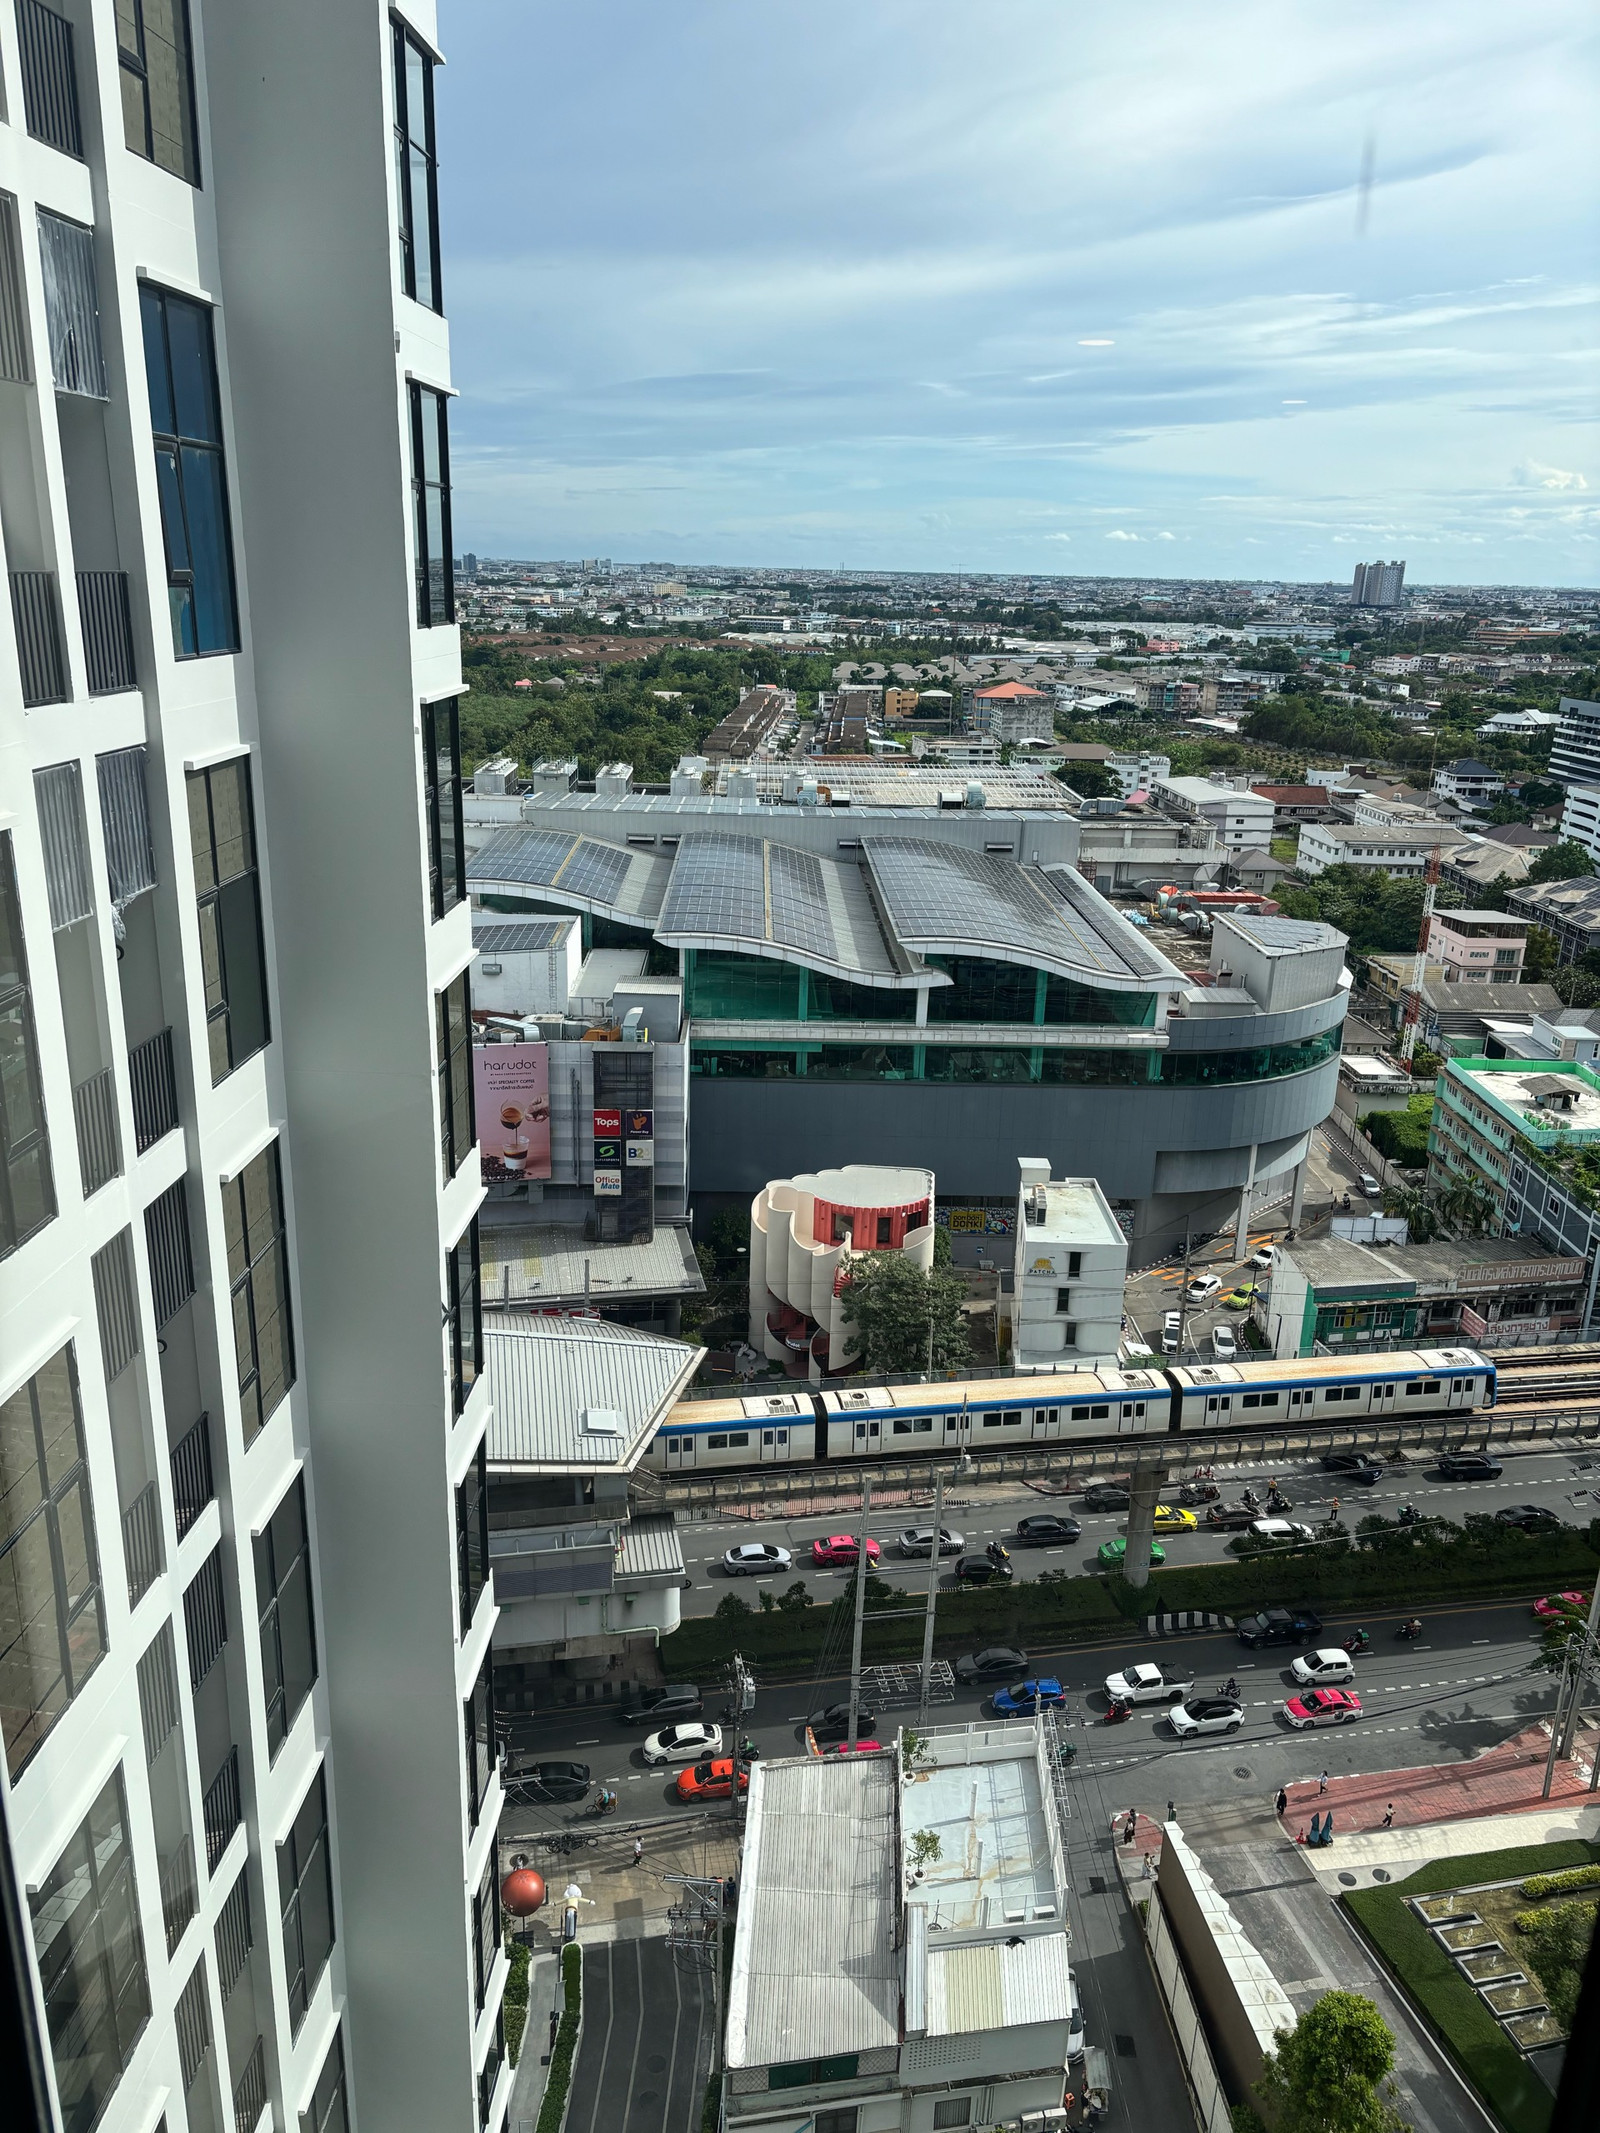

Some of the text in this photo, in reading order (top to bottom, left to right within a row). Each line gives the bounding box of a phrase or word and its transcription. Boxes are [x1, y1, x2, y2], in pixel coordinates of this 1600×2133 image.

[594, 1117, 619, 1128] Tops
[595, 1176, 620, 1184] Office
[953, 1220, 983, 1228] DONKI
